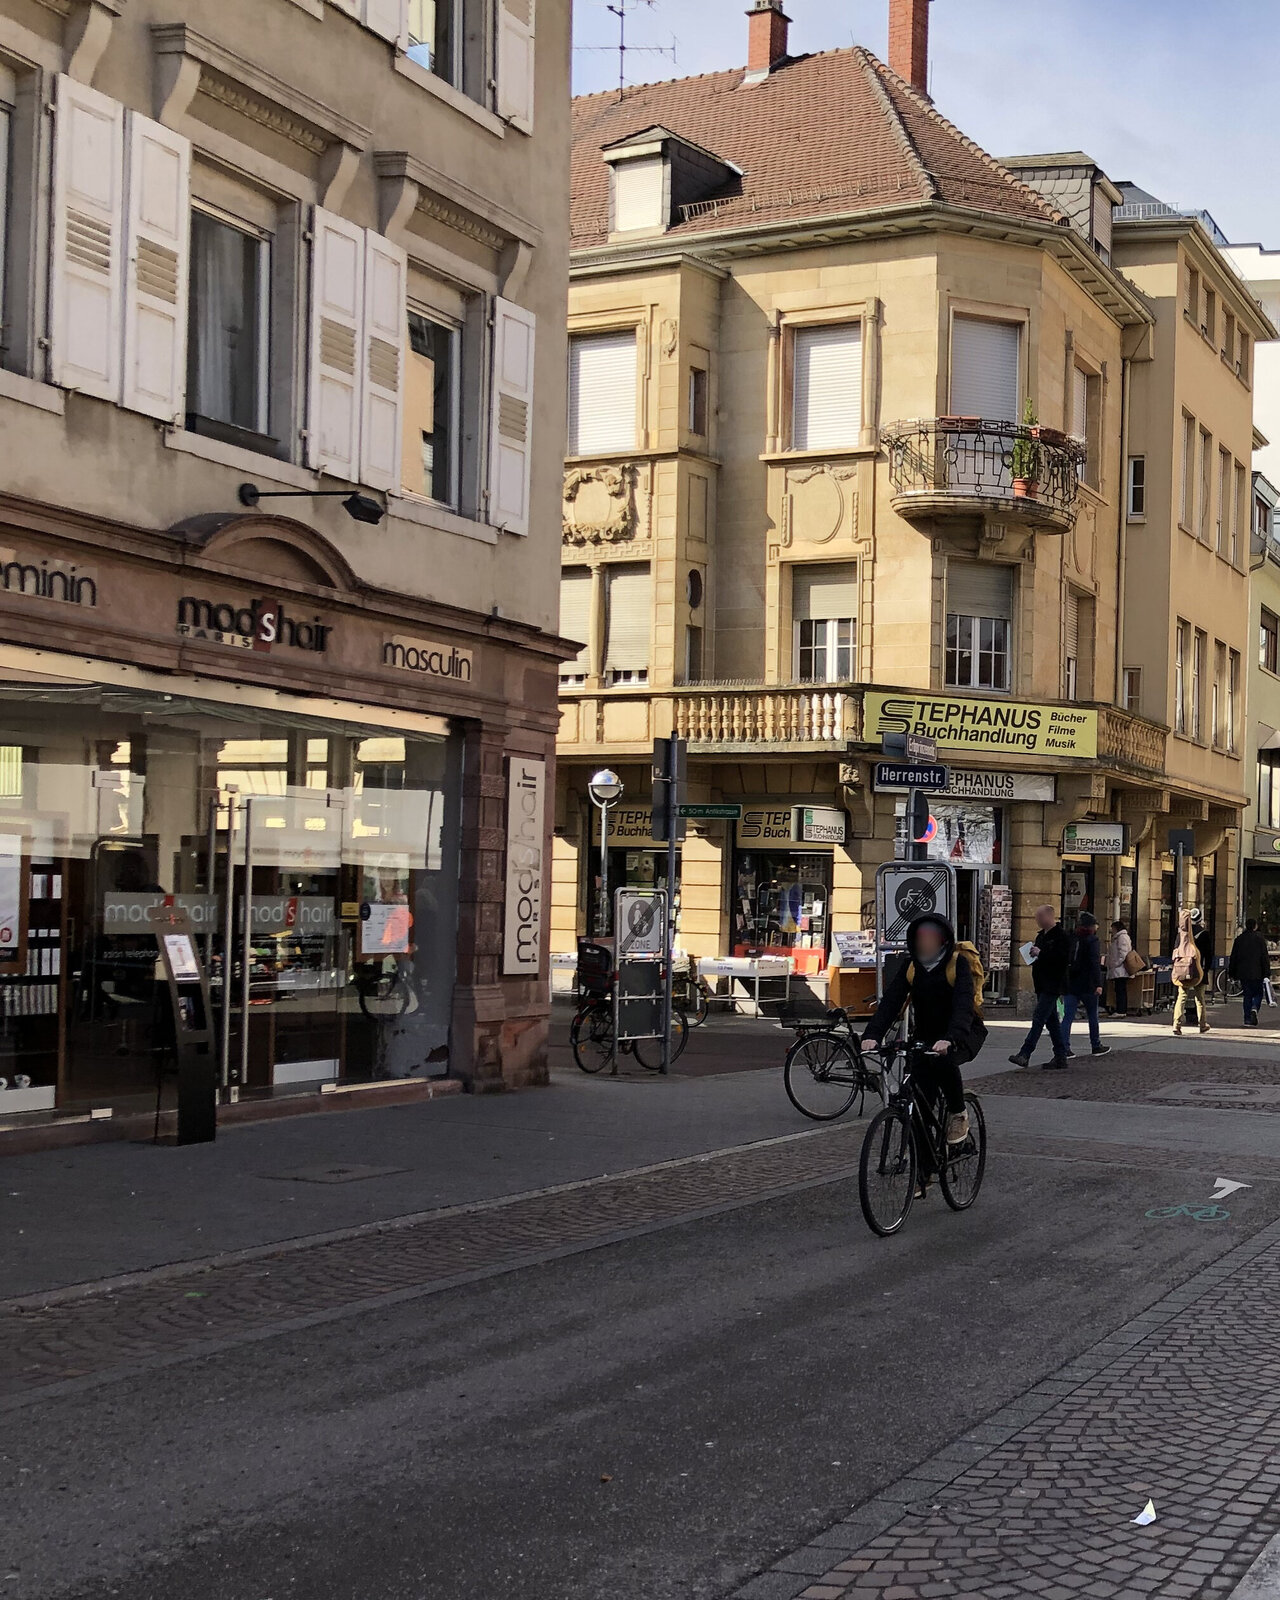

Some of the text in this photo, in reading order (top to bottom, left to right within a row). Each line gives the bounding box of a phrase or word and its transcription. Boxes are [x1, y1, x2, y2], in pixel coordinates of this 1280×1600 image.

[180, 624, 252, 648] PARIS
[382, 640, 472, 681] masculin
[877, 699, 1041, 732] STEPHANUS
[1050, 711, 1088, 724] Bücher
[913, 721, 1038, 750] Buchhandlung
[1047, 725, 1076, 736] Filme
[1045, 738, 1077, 750] Musik
[881, 766, 942, 784] Herrenstr.
[596, 811, 653, 830] STEPH
[617, 826, 653, 837] Buchha
[1066, 838, 1121, 850] STEPHANUS
[300, 899, 334, 924] hair
[531, 878, 540, 964] PARIS
